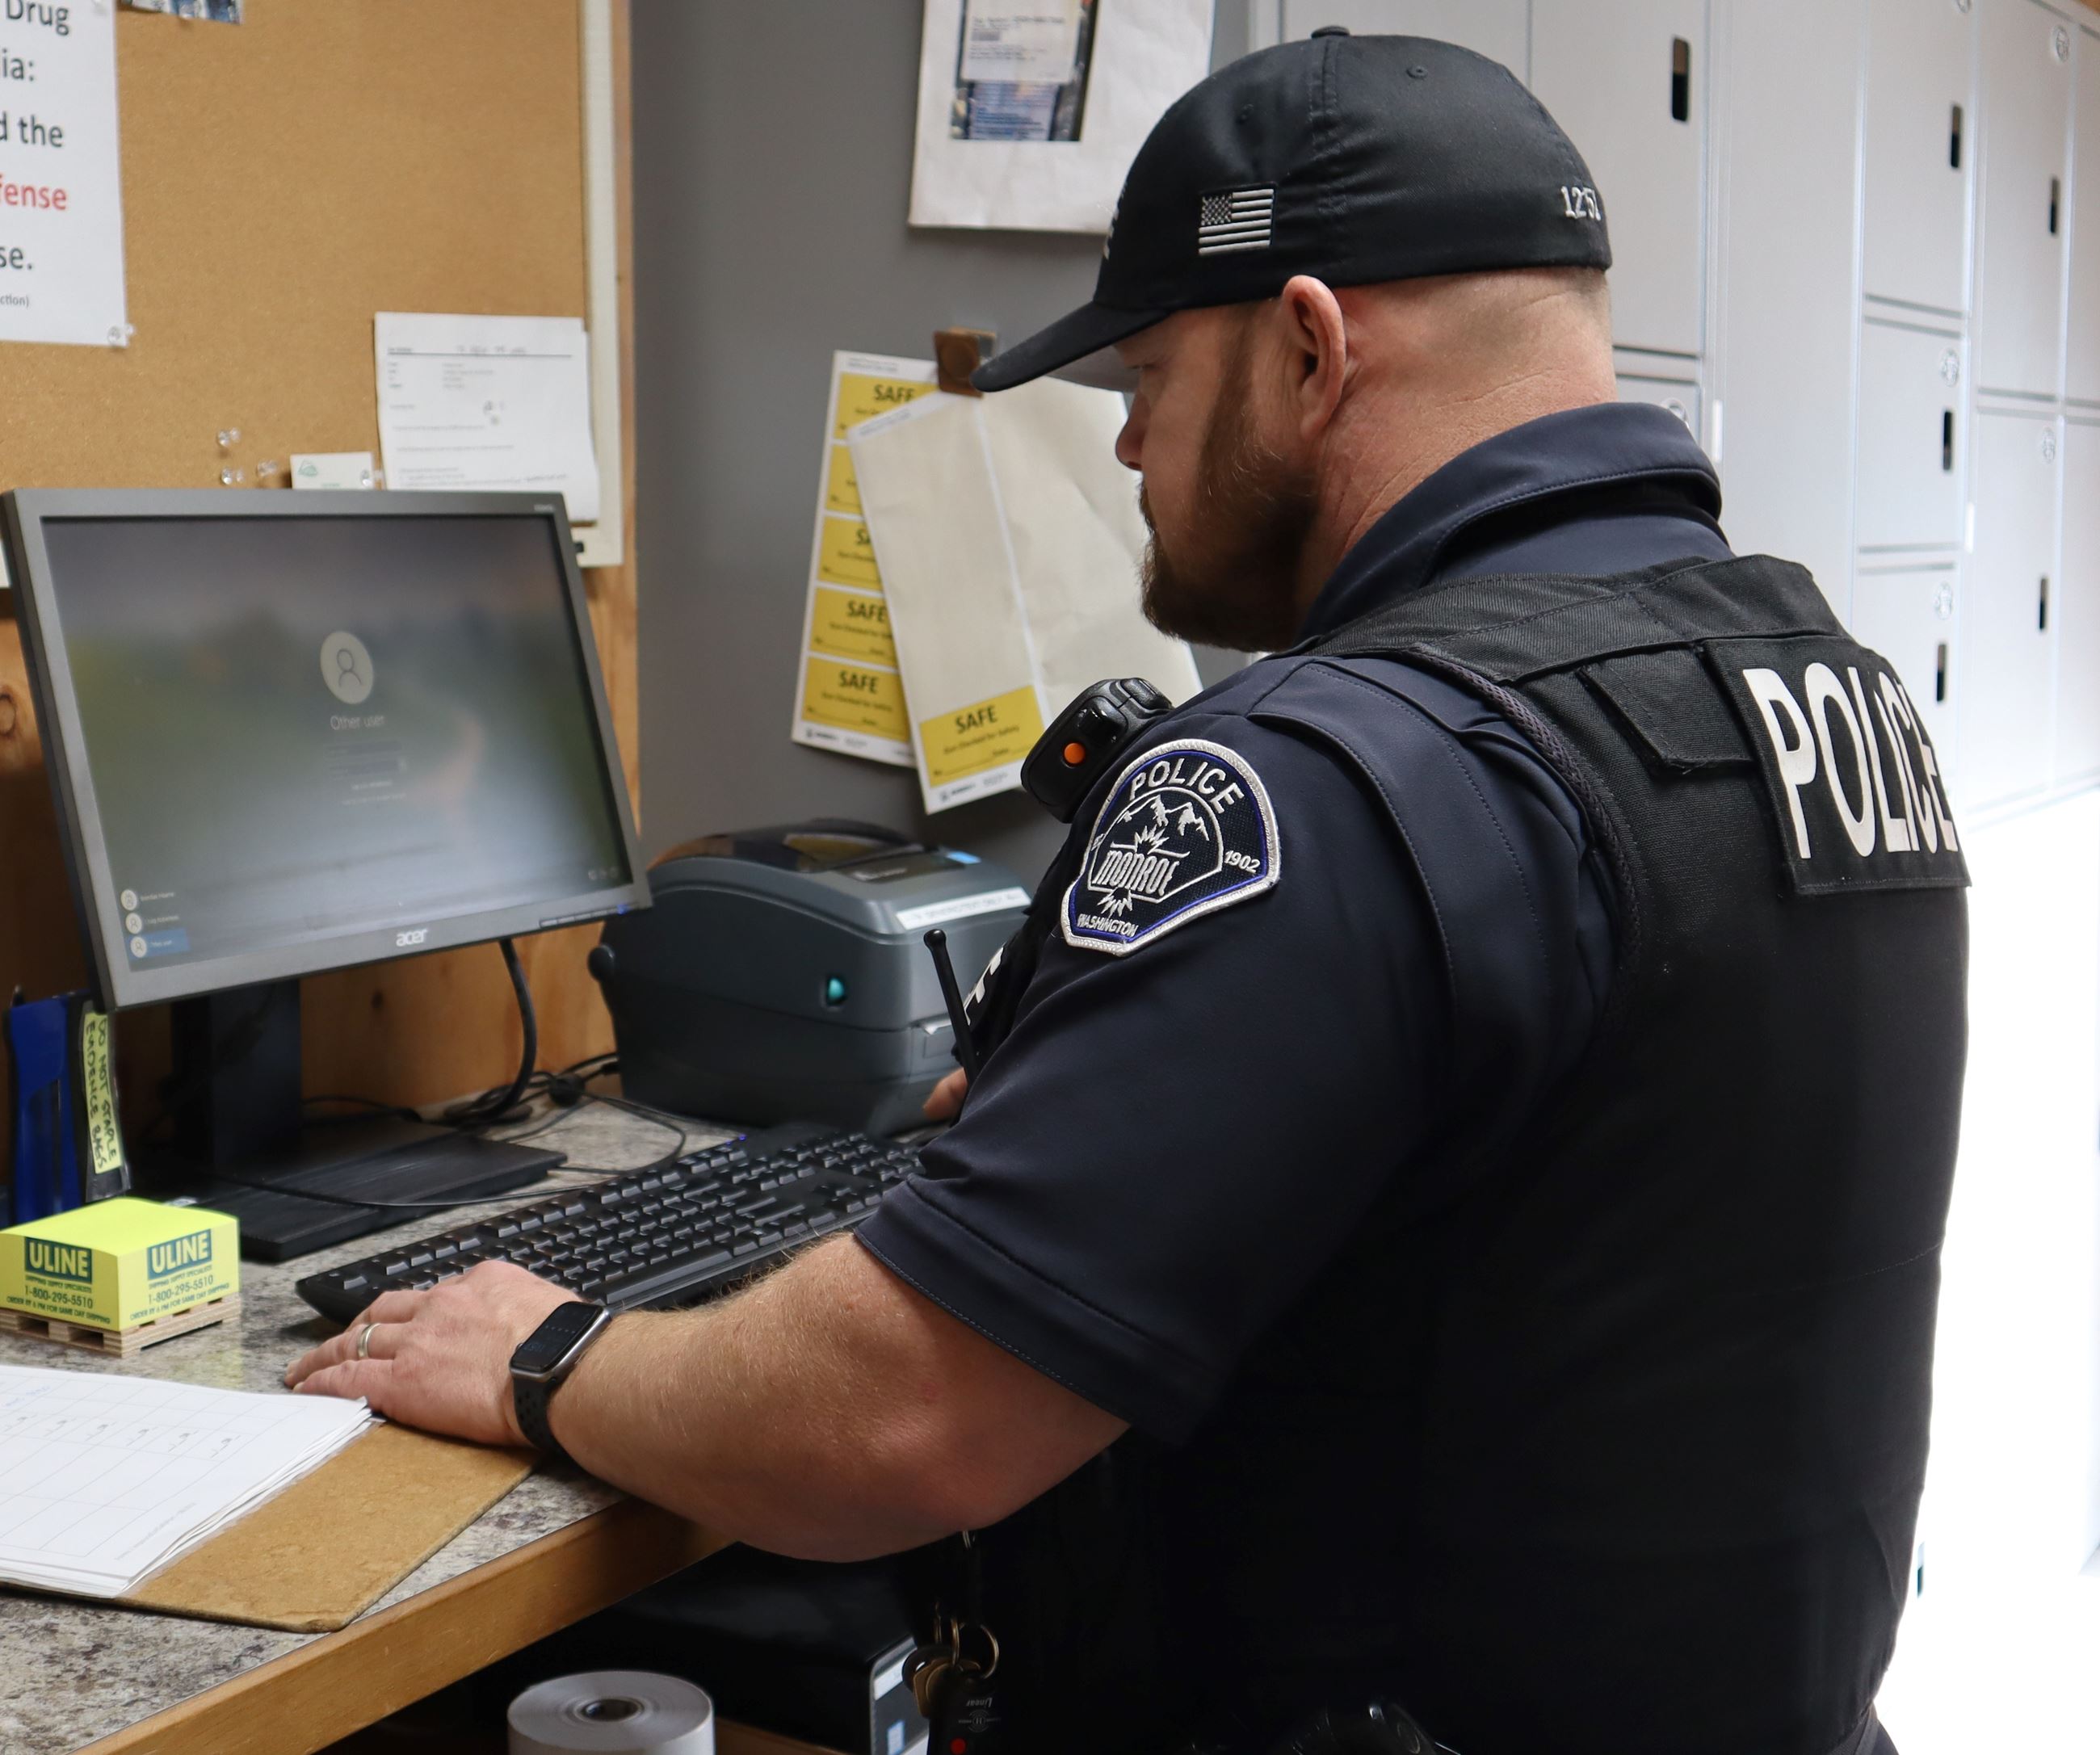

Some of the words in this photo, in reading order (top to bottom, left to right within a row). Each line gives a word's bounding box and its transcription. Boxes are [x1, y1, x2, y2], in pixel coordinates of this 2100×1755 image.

[6, 0, 69, 36] Drug
[18, 114, 62, 147] the
[0, 173, 66, 210] ense
[846, 600, 887, 623] SAFE
[838, 670, 879, 694] SAFE
[956, 705, 998, 734] SAFE
[1742, 662, 1958, 859] POLICE
[1129, 758, 1245, 814] POLICE
[1224, 850, 1261, 874] 1902
[396, 929, 428, 947] acer
[1077, 913, 1140, 938] WASHINGTON
[98, 1053, 110, 1095] NOT
[101, 1099, 116, 1161] STAPLE
[28, 1241, 90, 1278] ULINE
[150, 1232, 209, 1274] ULINE
[25, 1285, 93, 1308] 1-800-295-5510
[148, 1274, 214, 1305] 1-800-295-5510
